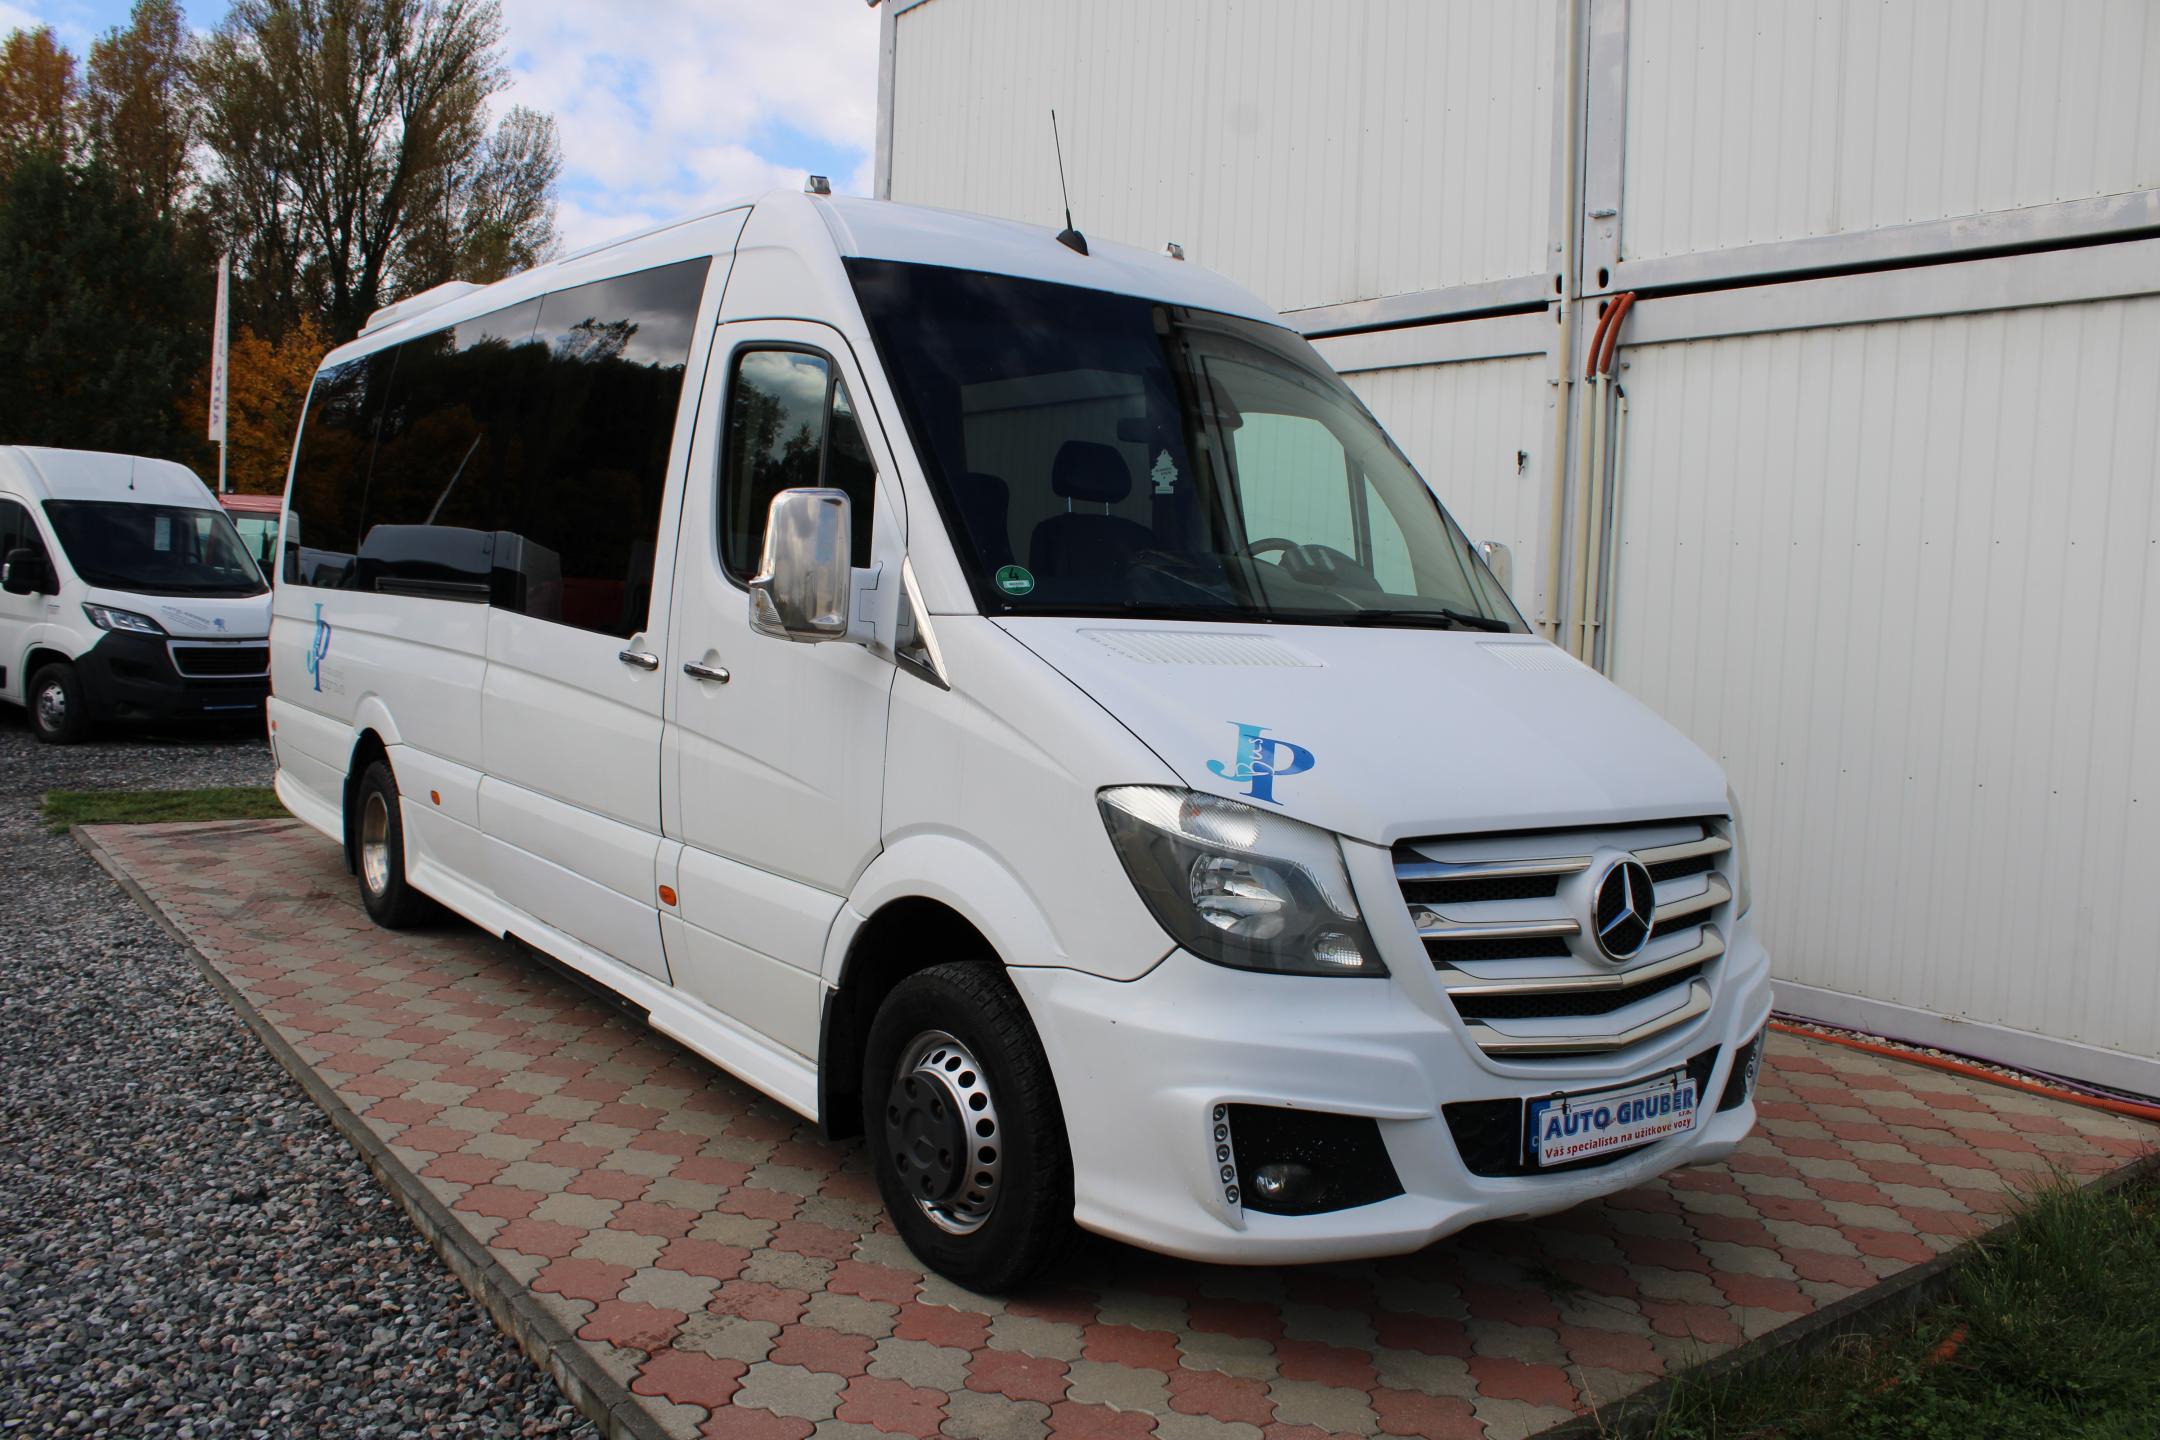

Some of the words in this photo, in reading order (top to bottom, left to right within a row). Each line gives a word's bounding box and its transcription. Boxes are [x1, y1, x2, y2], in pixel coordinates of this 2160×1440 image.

[1008, 567, 1019, 580] 4
[1543, 1106, 1611, 1141] AUTO
[1616, 1086, 1694, 1125] GRUBER
[1678, 1109, 1692, 1117] s.r.o.
[1545, 1145, 1565, 1159] Váš
[1566, 1135, 1619, 1156] specialista
[1620, 1132, 1633, 1143] na
[1673, 1117, 1692, 1129] vozy
